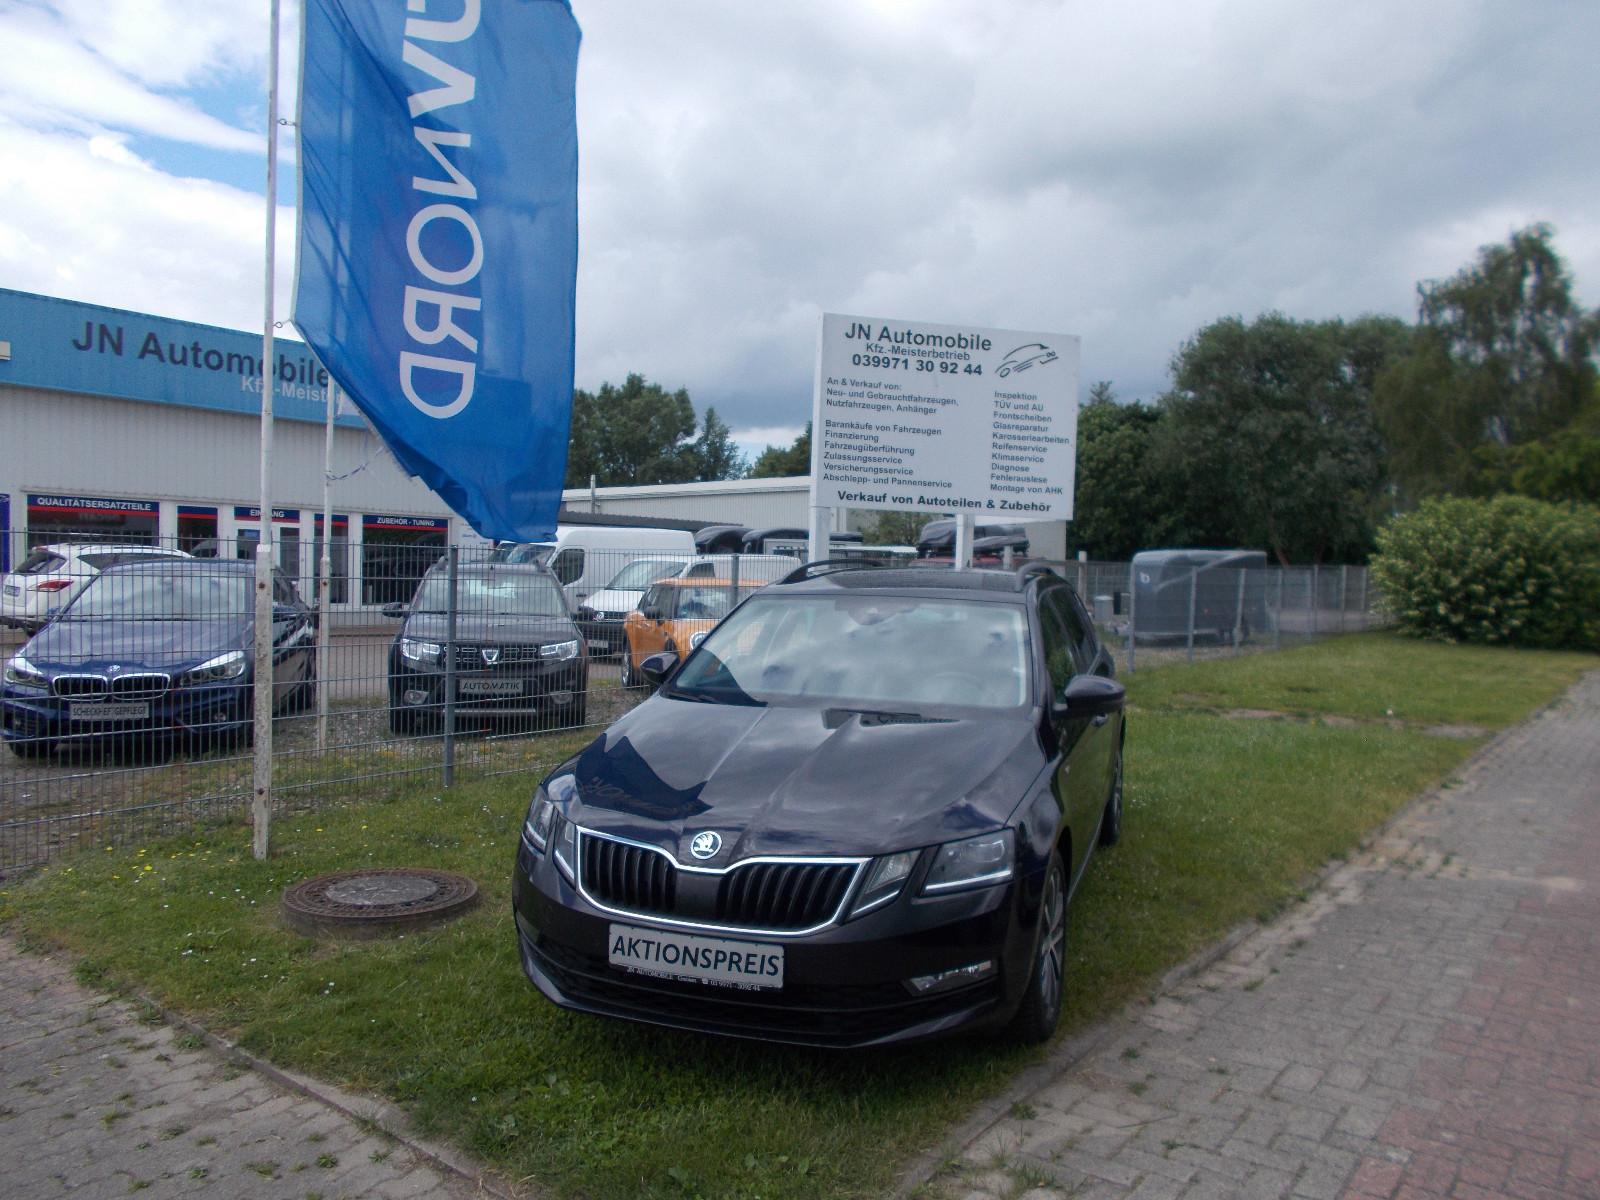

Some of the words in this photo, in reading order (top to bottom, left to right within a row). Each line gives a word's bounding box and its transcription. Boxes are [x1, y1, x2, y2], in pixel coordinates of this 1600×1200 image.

[72, 321, 124, 357] JN
[845, 322, 871, 341] JN
[878, 326, 992, 351] Automobile
[866, 342, 970, 361] Kfz.-Meisterbetrieb
[852, 353, 909, 371] 039971
[916, 359, 935, 373] 30
[939, 361, 959, 374] 92
[963, 363, 983, 376] 44
[827, 377, 839, 386] An
[850, 379, 882, 389] Verkauf
[826, 387, 846, 397] Neu-
[848, 390, 865, 399] und
[994, 391, 1037, 401] Inspektion
[896, 403, 937, 416] Anhänger
[994, 400, 1011, 409] TÜV
[1013, 403, 1030, 411] und
[1032, 403, 1044, 411] AU
[993, 411, 1052, 422] Frontscheiben
[825, 419, 873, 431] Barankäufe
[875, 424, 891, 432] von
[893, 424, 942, 436] Fahrzeugen
[993, 422, 1048, 432] Glasreparatur
[825, 430, 879, 443] Finanzierung
[992, 432, 1070, 444] Karosseriearbeiten
[824, 441, 915, 456] Fahrzeugüberführung
[992, 442, 1048, 453] Reifenservice
[824, 452, 903, 464] Zulassungsservice
[991, 453, 1045, 463] Klimaservice
[824, 462, 914, 475] Versicherungsservice
[991, 463, 1030, 473] Diagnose
[823, 473, 871, 485] Abschlepp-
[873, 477, 889, 485] und
[891, 477, 952, 488] Pannenservice
[990, 473, 1048, 483] Fehlerauslese
[990, 483, 1025, 493] Montage
[1045, 486, 1063, 494] AHK
[838, 490, 888, 503] Verkauf
[891, 495, 913, 506] von
[917, 495, 982, 509] Autoteilen
[986, 498, 996, 509] &
[1000, 498, 1052, 512] Zubehör
[250, 509, 285, 518] EINNG
[413, 519, 435, 527] TUNING
[463, 682, 520, 690] AUTOMATIK
[612, 935, 779, 976] AKTIONSPREIS
